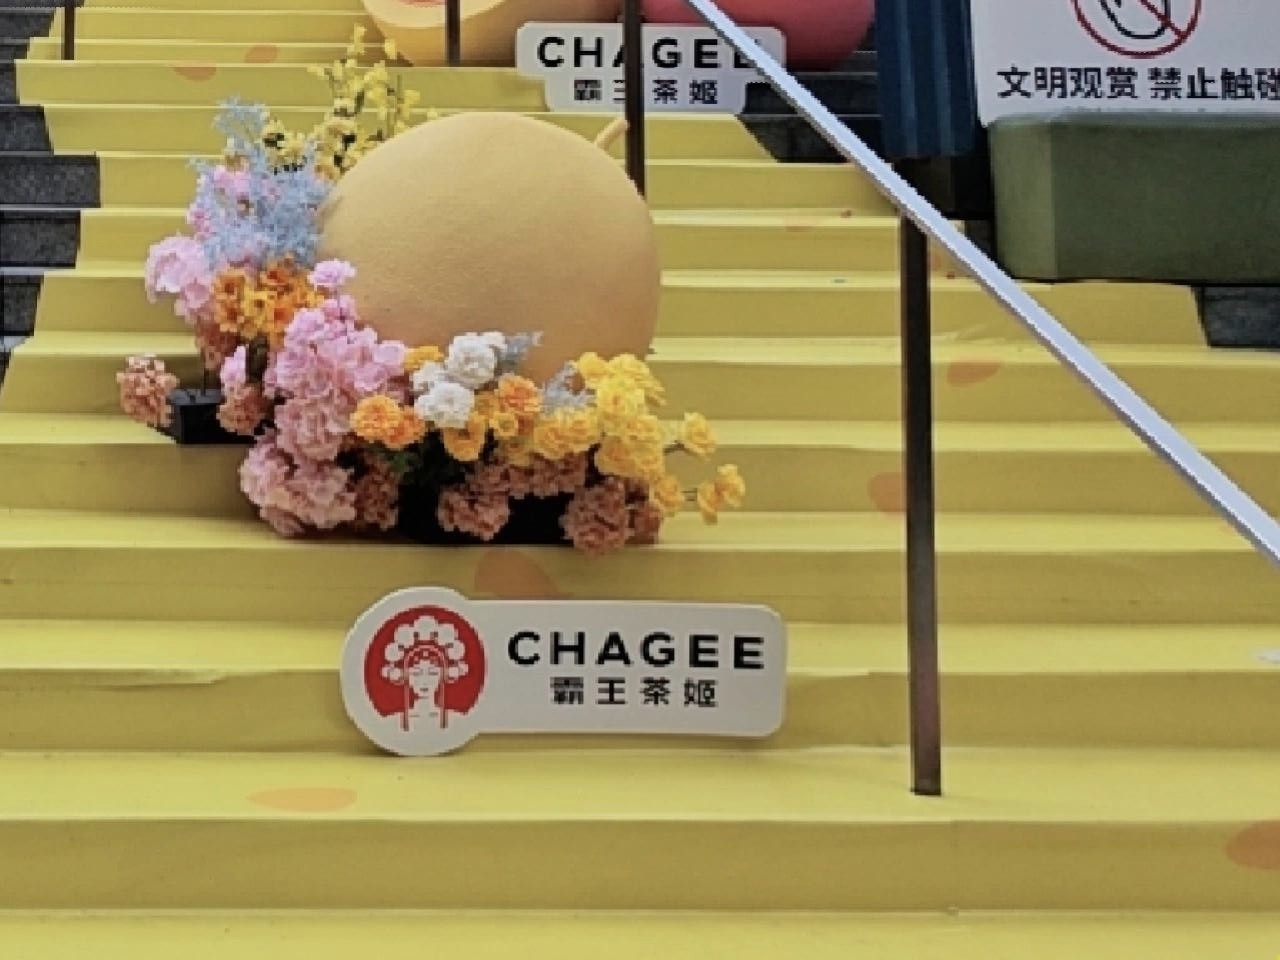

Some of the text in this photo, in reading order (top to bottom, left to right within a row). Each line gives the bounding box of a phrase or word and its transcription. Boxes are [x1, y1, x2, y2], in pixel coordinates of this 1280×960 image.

[996, 64, 1138, 99] 文明观赏
[507, 631, 765, 670] CHAGEE
[549, 676, 719, 708] 霸王茶姬
